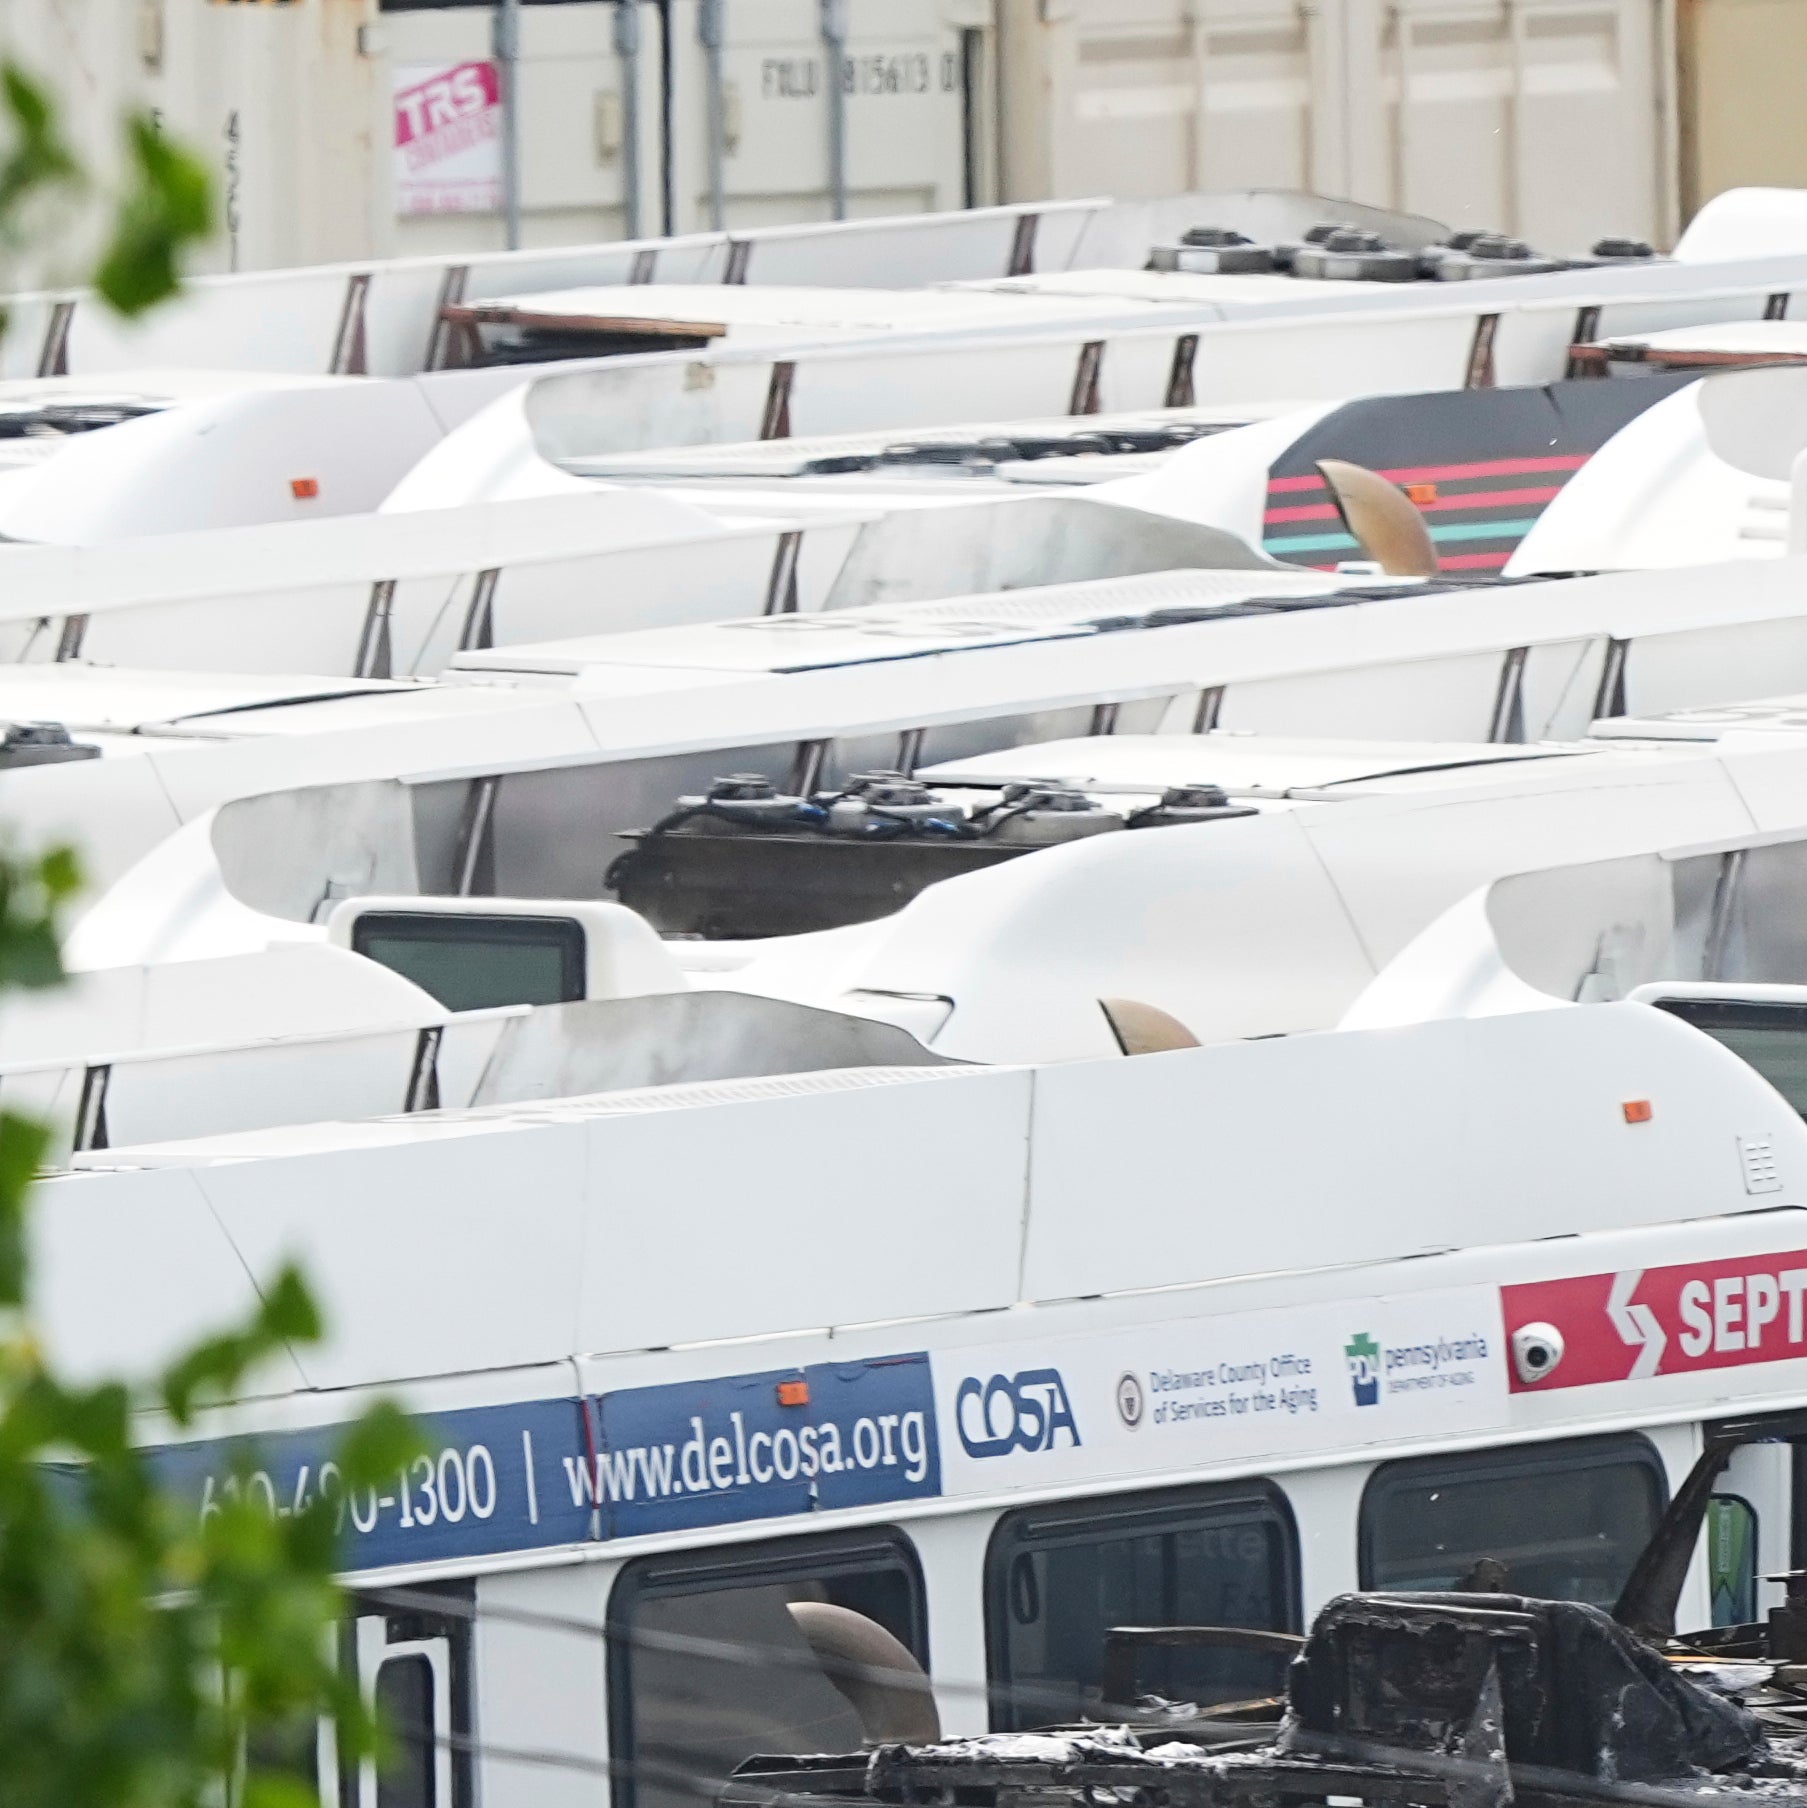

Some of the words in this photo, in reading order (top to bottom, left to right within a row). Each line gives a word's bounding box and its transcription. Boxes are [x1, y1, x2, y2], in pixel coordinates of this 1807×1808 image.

[398, 65, 487, 138] TRS
[1149, 1370, 1215, 1393] Delaware
[1219, 1362, 1267, 1387] County
[1270, 1354, 1312, 1378] Office
[1385, 1332, 1488, 1376] pennsylvania
[956, 1357, 1083, 1459] COSA
[1153, 1401, 1168, 1425] of
[1171, 1396, 1228, 1422] Services
[1229, 1392, 1250, 1414] for
[1252, 1389, 1276, 1412] the
[1278, 1385, 1318, 1414] Aging
[562, 1410, 928, 1508] www.delcosa.org
